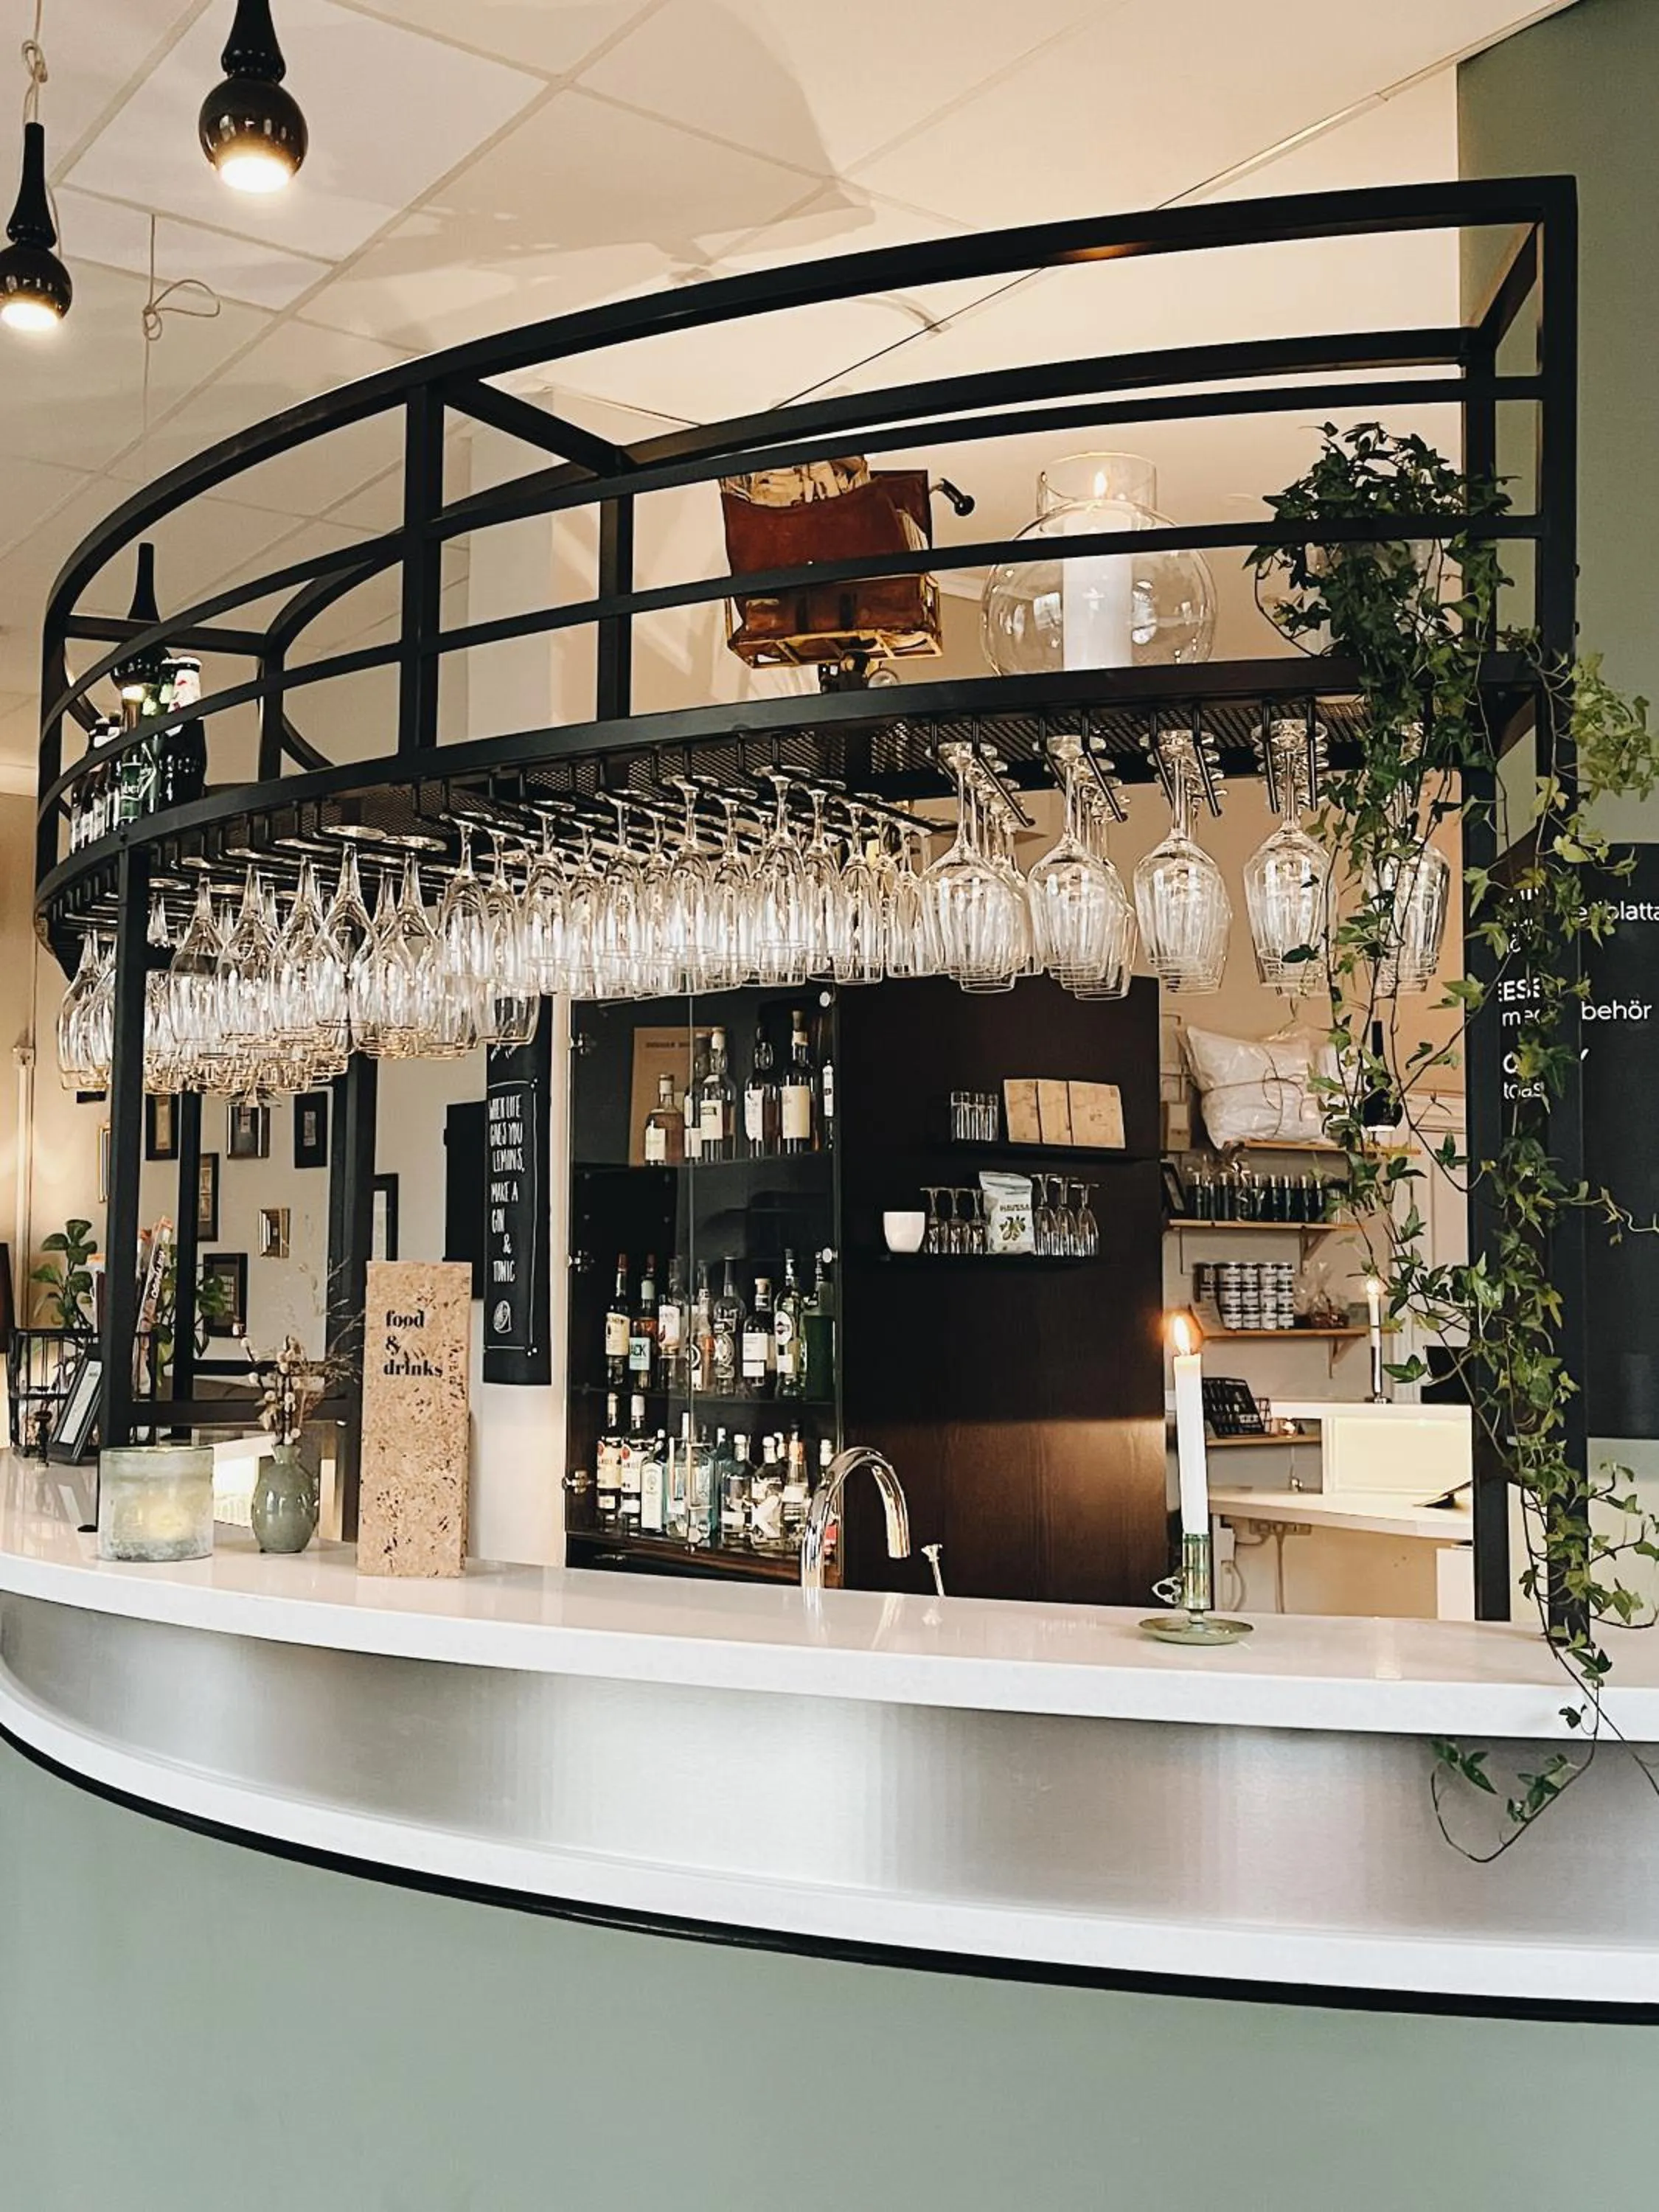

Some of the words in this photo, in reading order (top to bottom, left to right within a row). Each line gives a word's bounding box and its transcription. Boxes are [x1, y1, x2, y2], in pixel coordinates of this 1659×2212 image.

[1580, 999, 1652, 1020] behör
[508, 1121, 523, 1144] YOU
[490, 1180, 510, 1203] MAKE
[511, 1180, 518, 1203] A
[503, 1233, 512, 1253] &
[493, 1259, 515, 1282] TONIC
[386, 1310, 425, 1328] food
[385, 1335, 401, 1356] &
[383, 1359, 443, 1377] drinks
